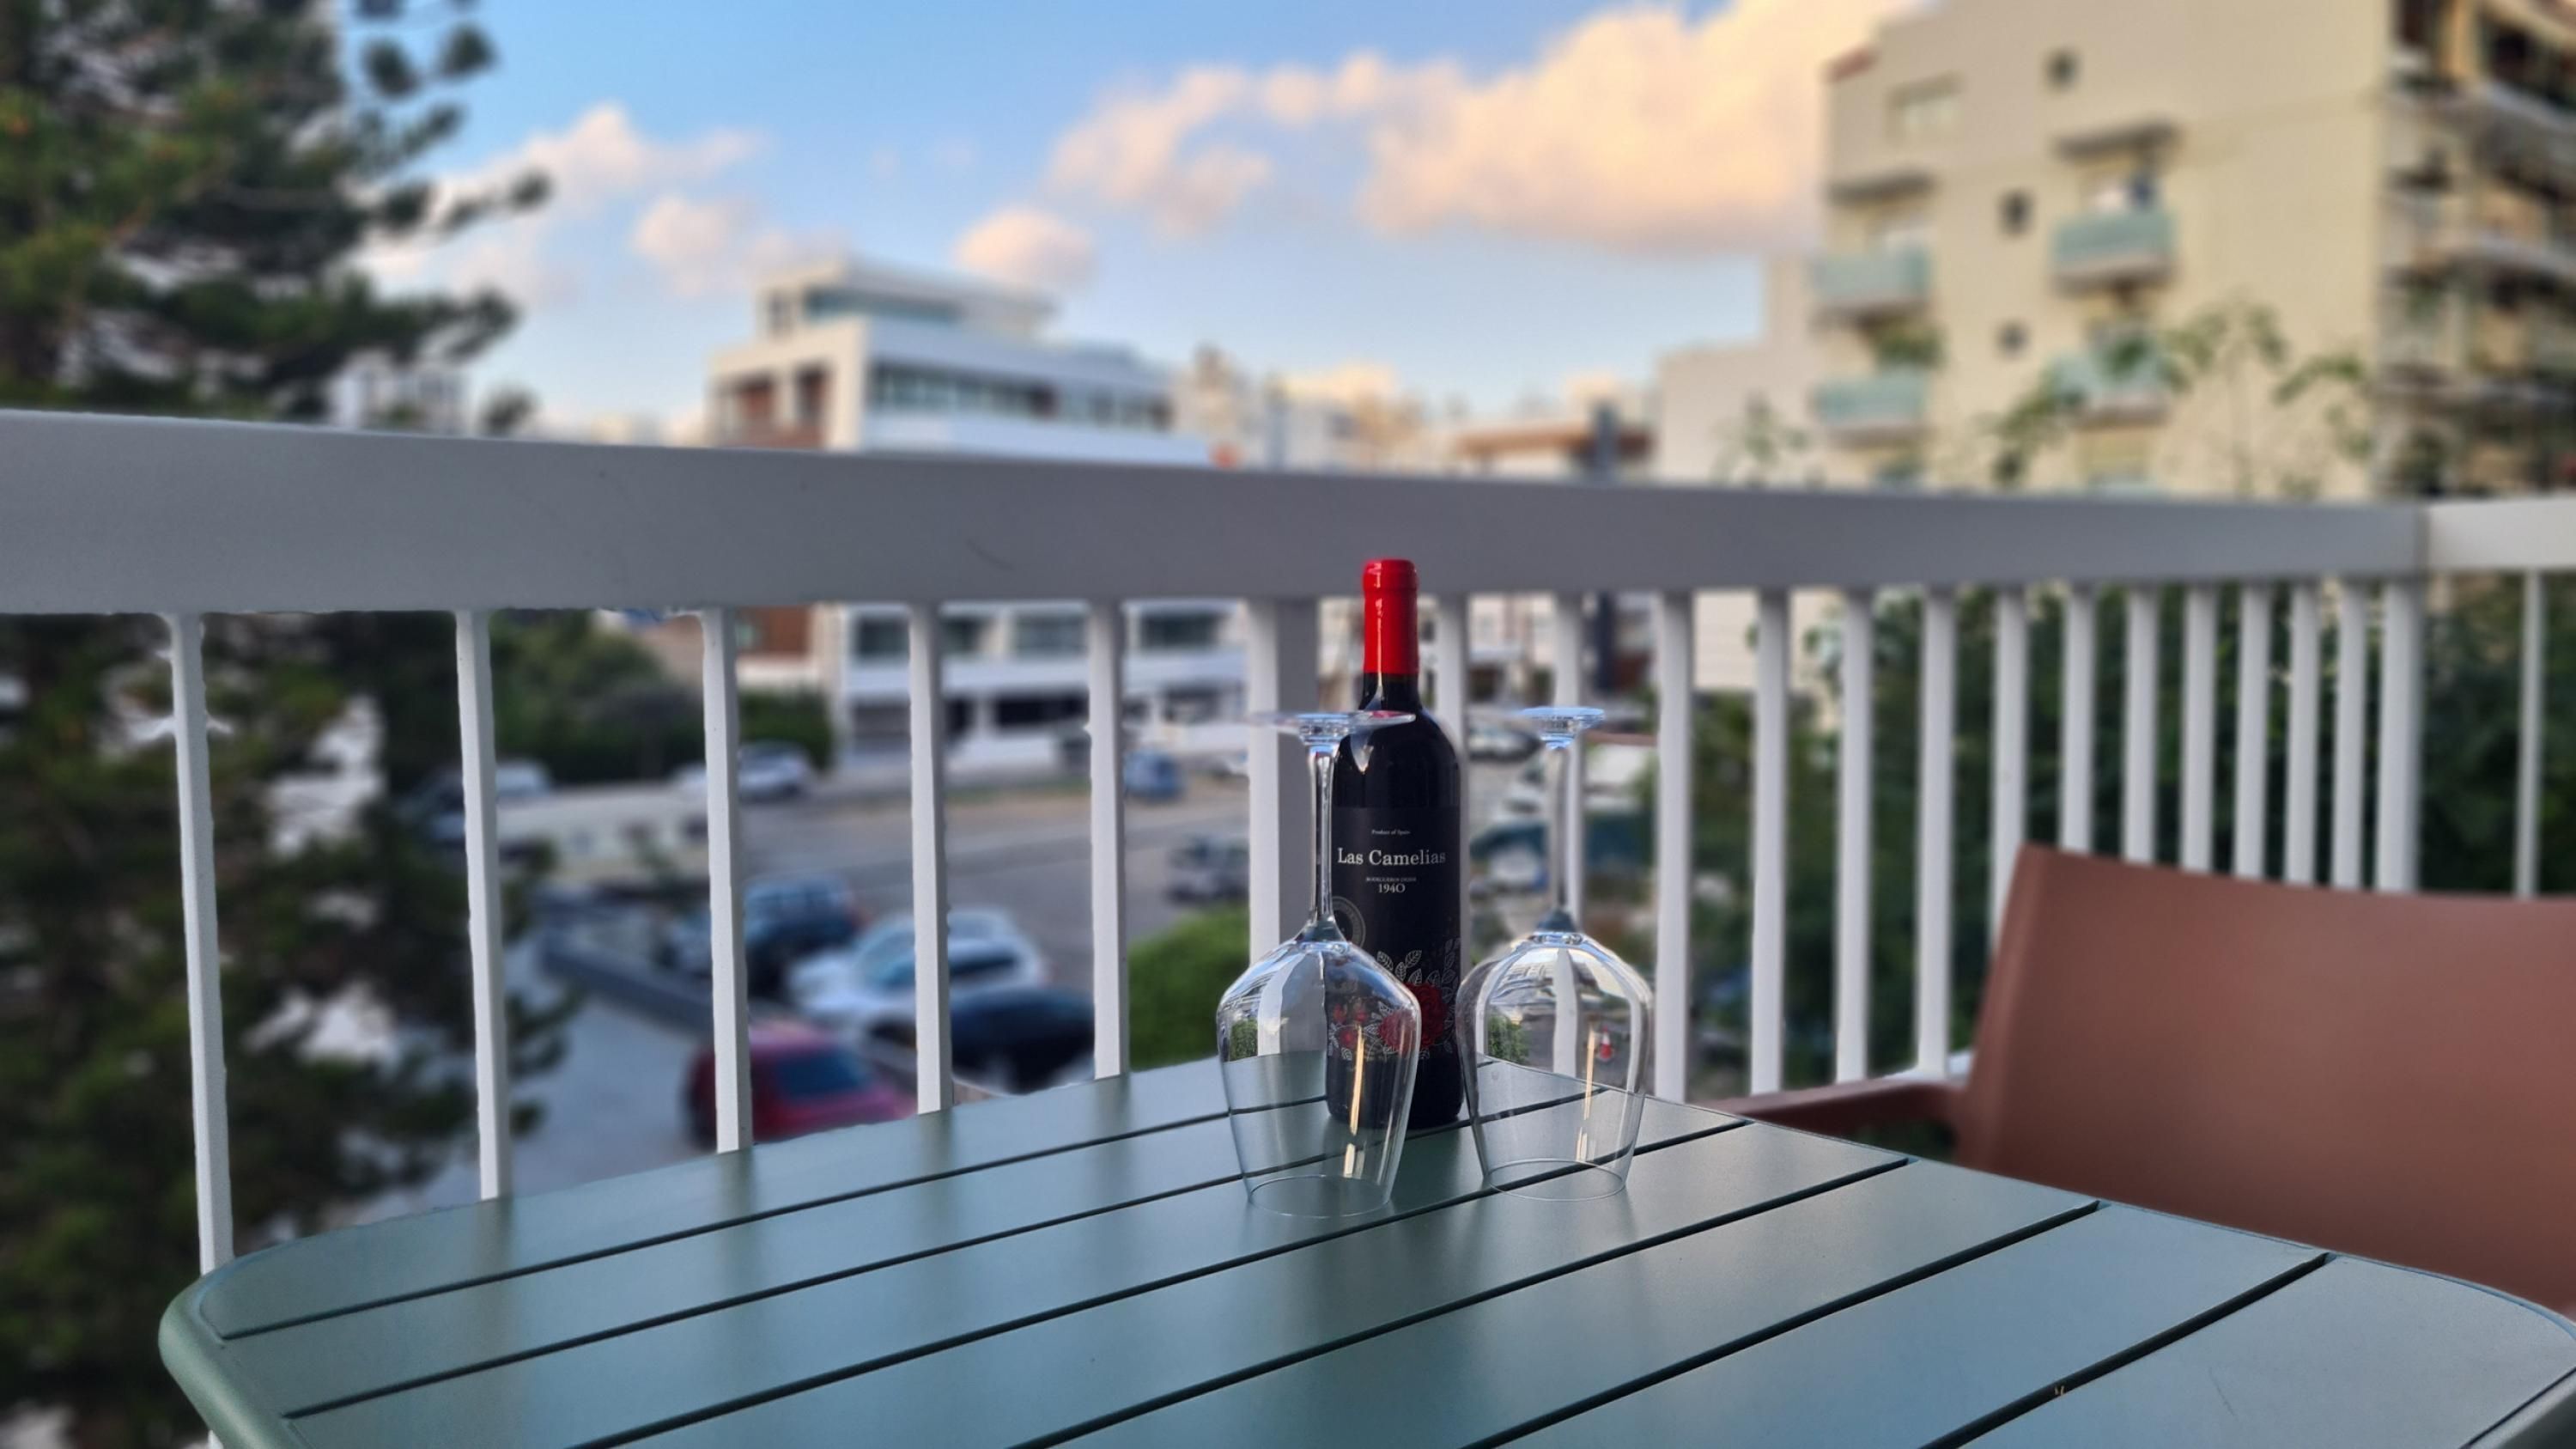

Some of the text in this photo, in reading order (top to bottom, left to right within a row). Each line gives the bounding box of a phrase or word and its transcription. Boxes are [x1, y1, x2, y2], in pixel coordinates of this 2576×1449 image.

[1337, 847, 1446, 866] Las Camelias
[1378, 883, 1406, 893] 1940
